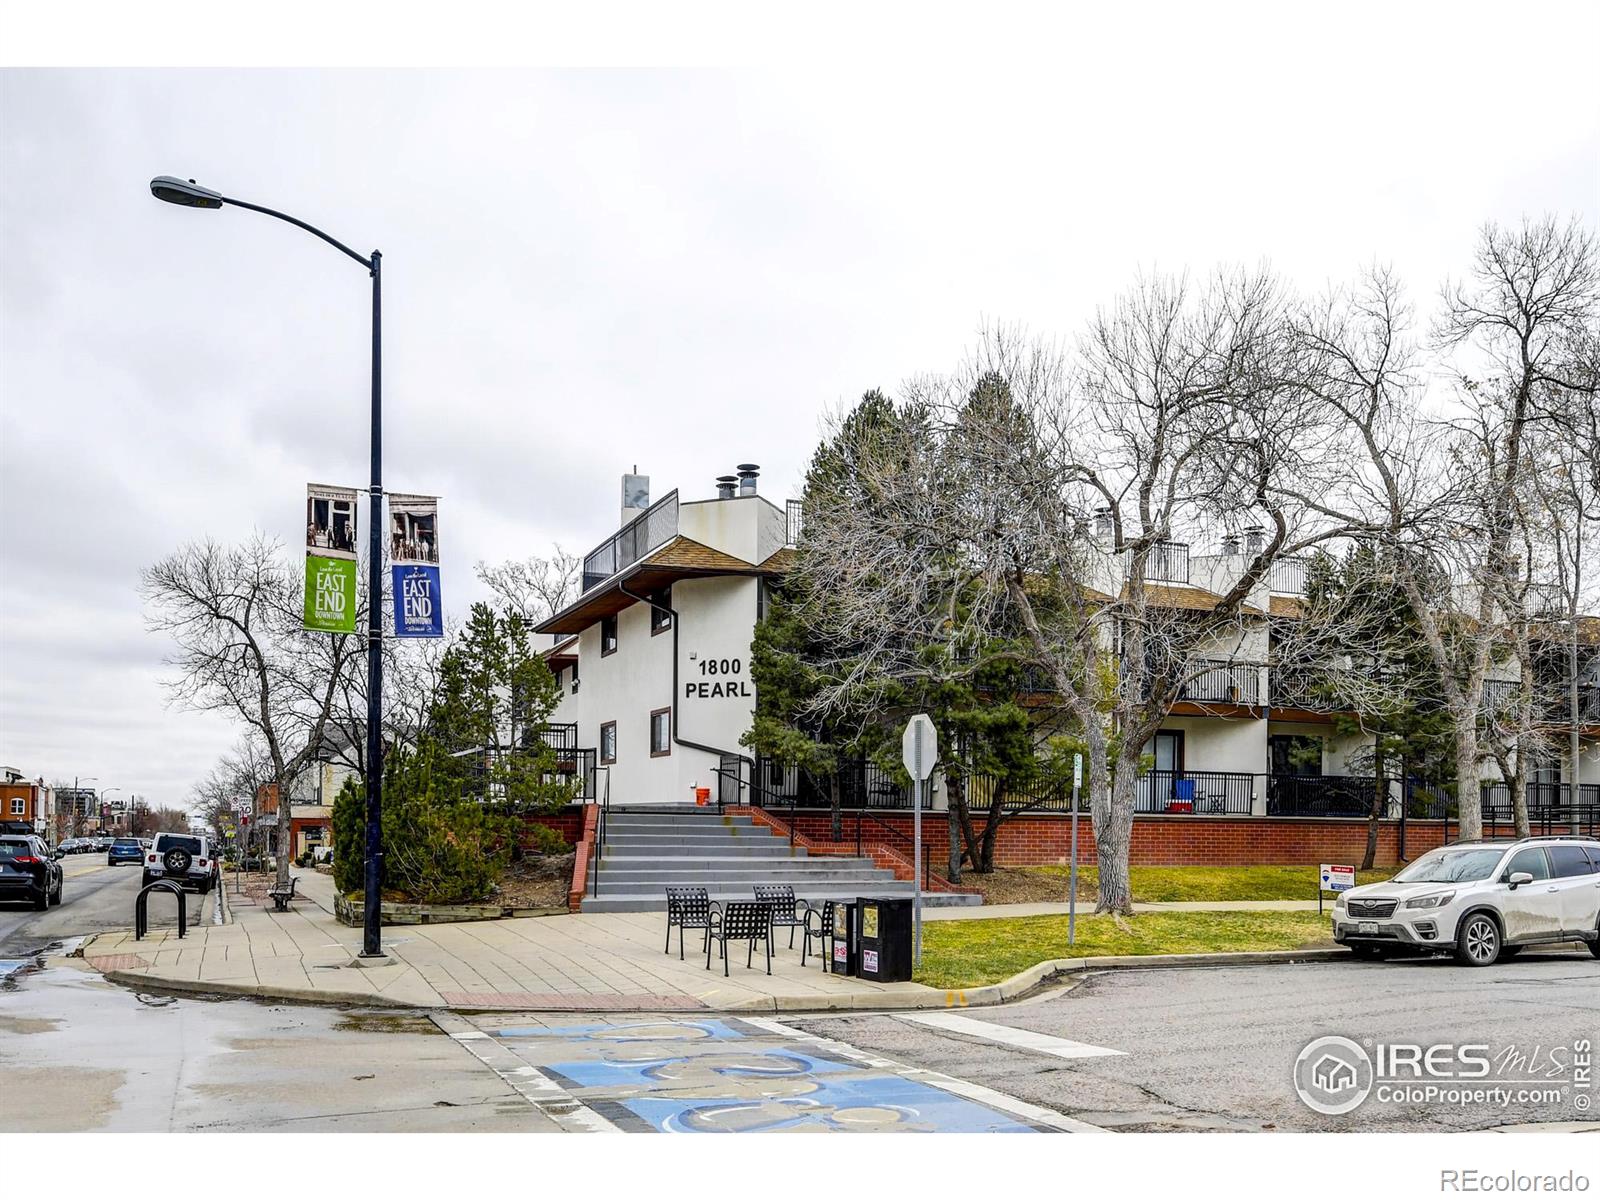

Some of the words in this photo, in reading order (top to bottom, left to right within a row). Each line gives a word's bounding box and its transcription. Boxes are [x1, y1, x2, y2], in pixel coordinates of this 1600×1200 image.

[316, 572, 346, 592] EAST
[403, 579, 431, 597] EAST
[315, 590, 346, 612] END
[404, 597, 432, 617] END
[315, 610, 345, 621] DOWNTOWN
[699, 658, 741, 676] 1800
[685, 681, 751, 698] PEARL
